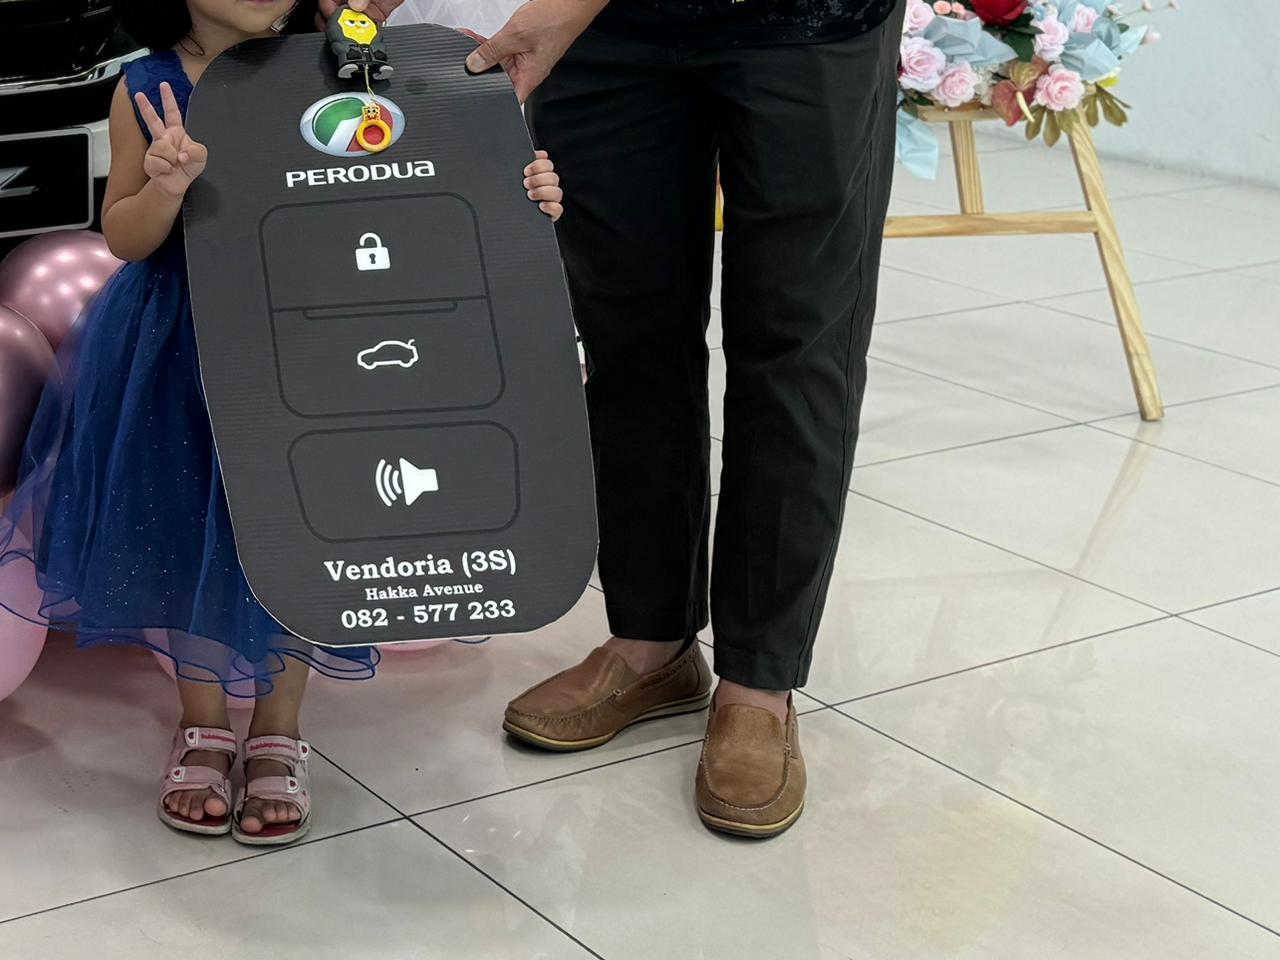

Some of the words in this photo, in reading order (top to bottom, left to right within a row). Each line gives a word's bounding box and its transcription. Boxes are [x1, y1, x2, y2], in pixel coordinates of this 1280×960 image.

[324, 553, 454, 582] Vendoria
[462, 548, 516, 578] (3S)
[365, 586, 418, 601] Hakka
[423, 582, 484, 598] Avenue
[341, 608, 389, 628] 082
[414, 603, 459, 623] 577
[468, 599, 516, 620] 233
